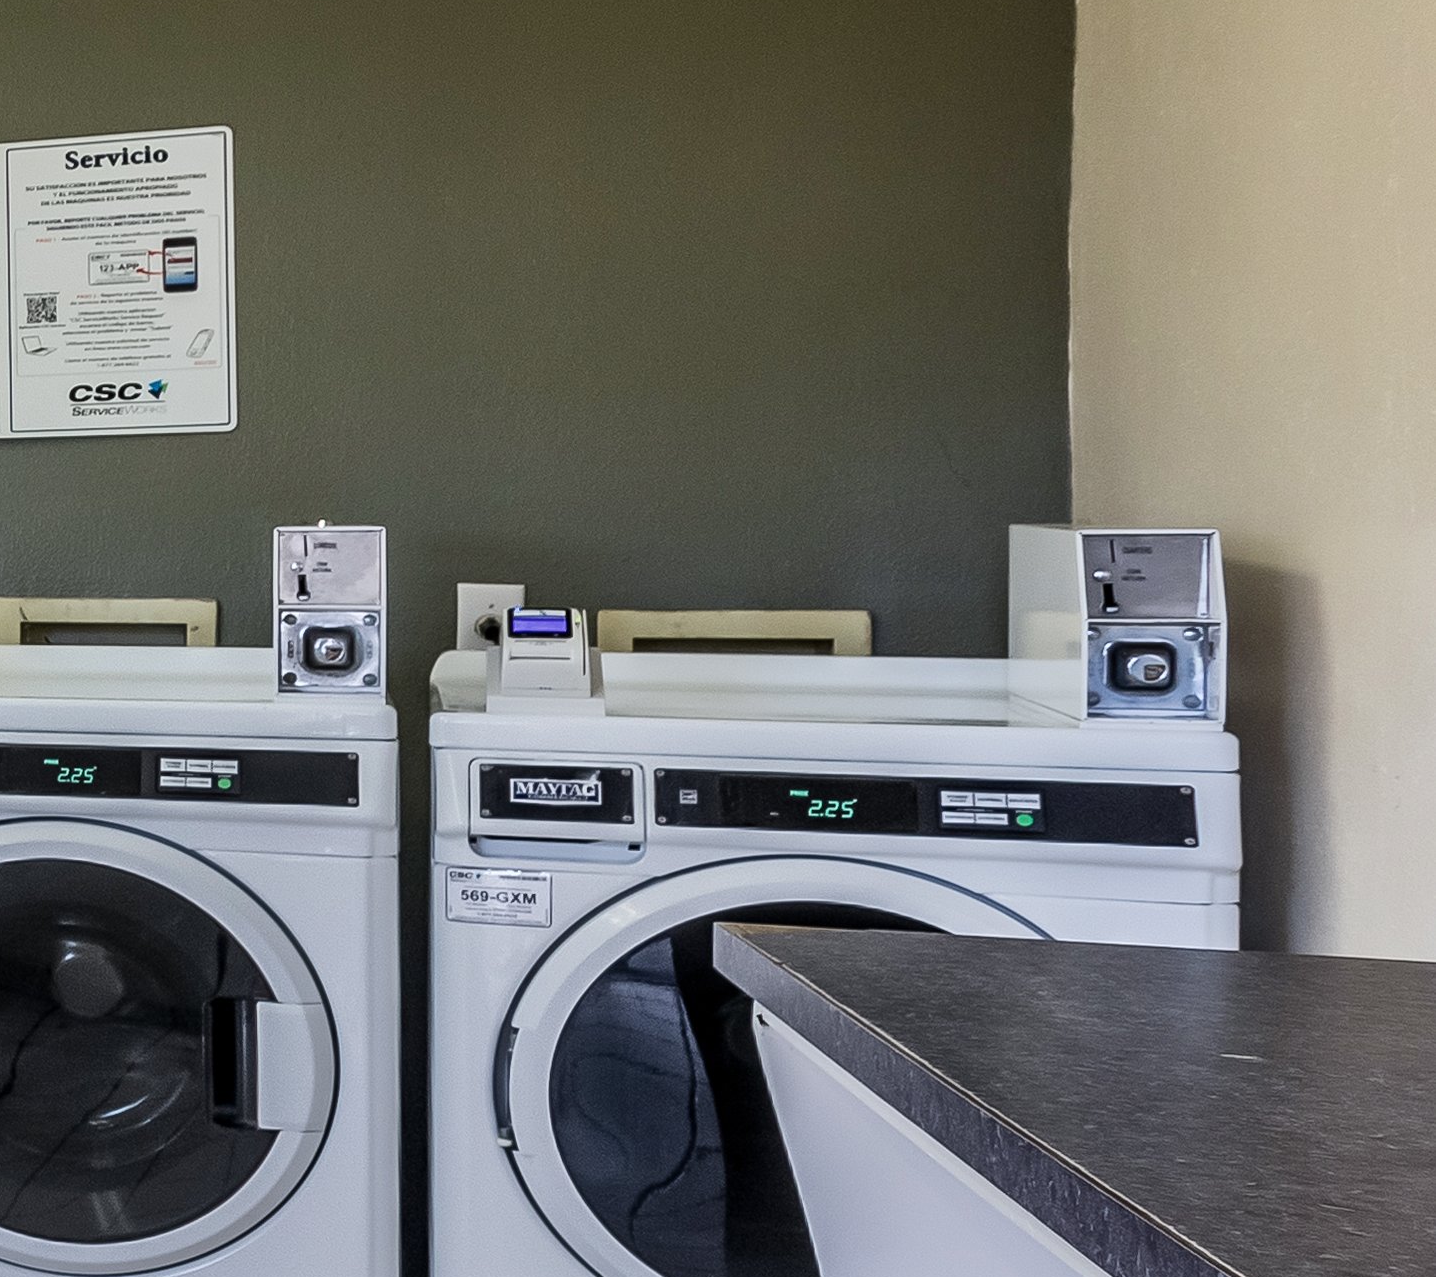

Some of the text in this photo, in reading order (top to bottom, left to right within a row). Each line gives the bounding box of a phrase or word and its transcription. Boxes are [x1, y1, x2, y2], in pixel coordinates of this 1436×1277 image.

[65, 145, 168, 170] Servicio
[69, 382, 143, 402] CSC
[57, 767, 94, 783] 2.25
[515, 781, 596, 797] MAYTAG
[808, 800, 854, 818] 2.25
[460, 889, 537, 905] 569-GXM
